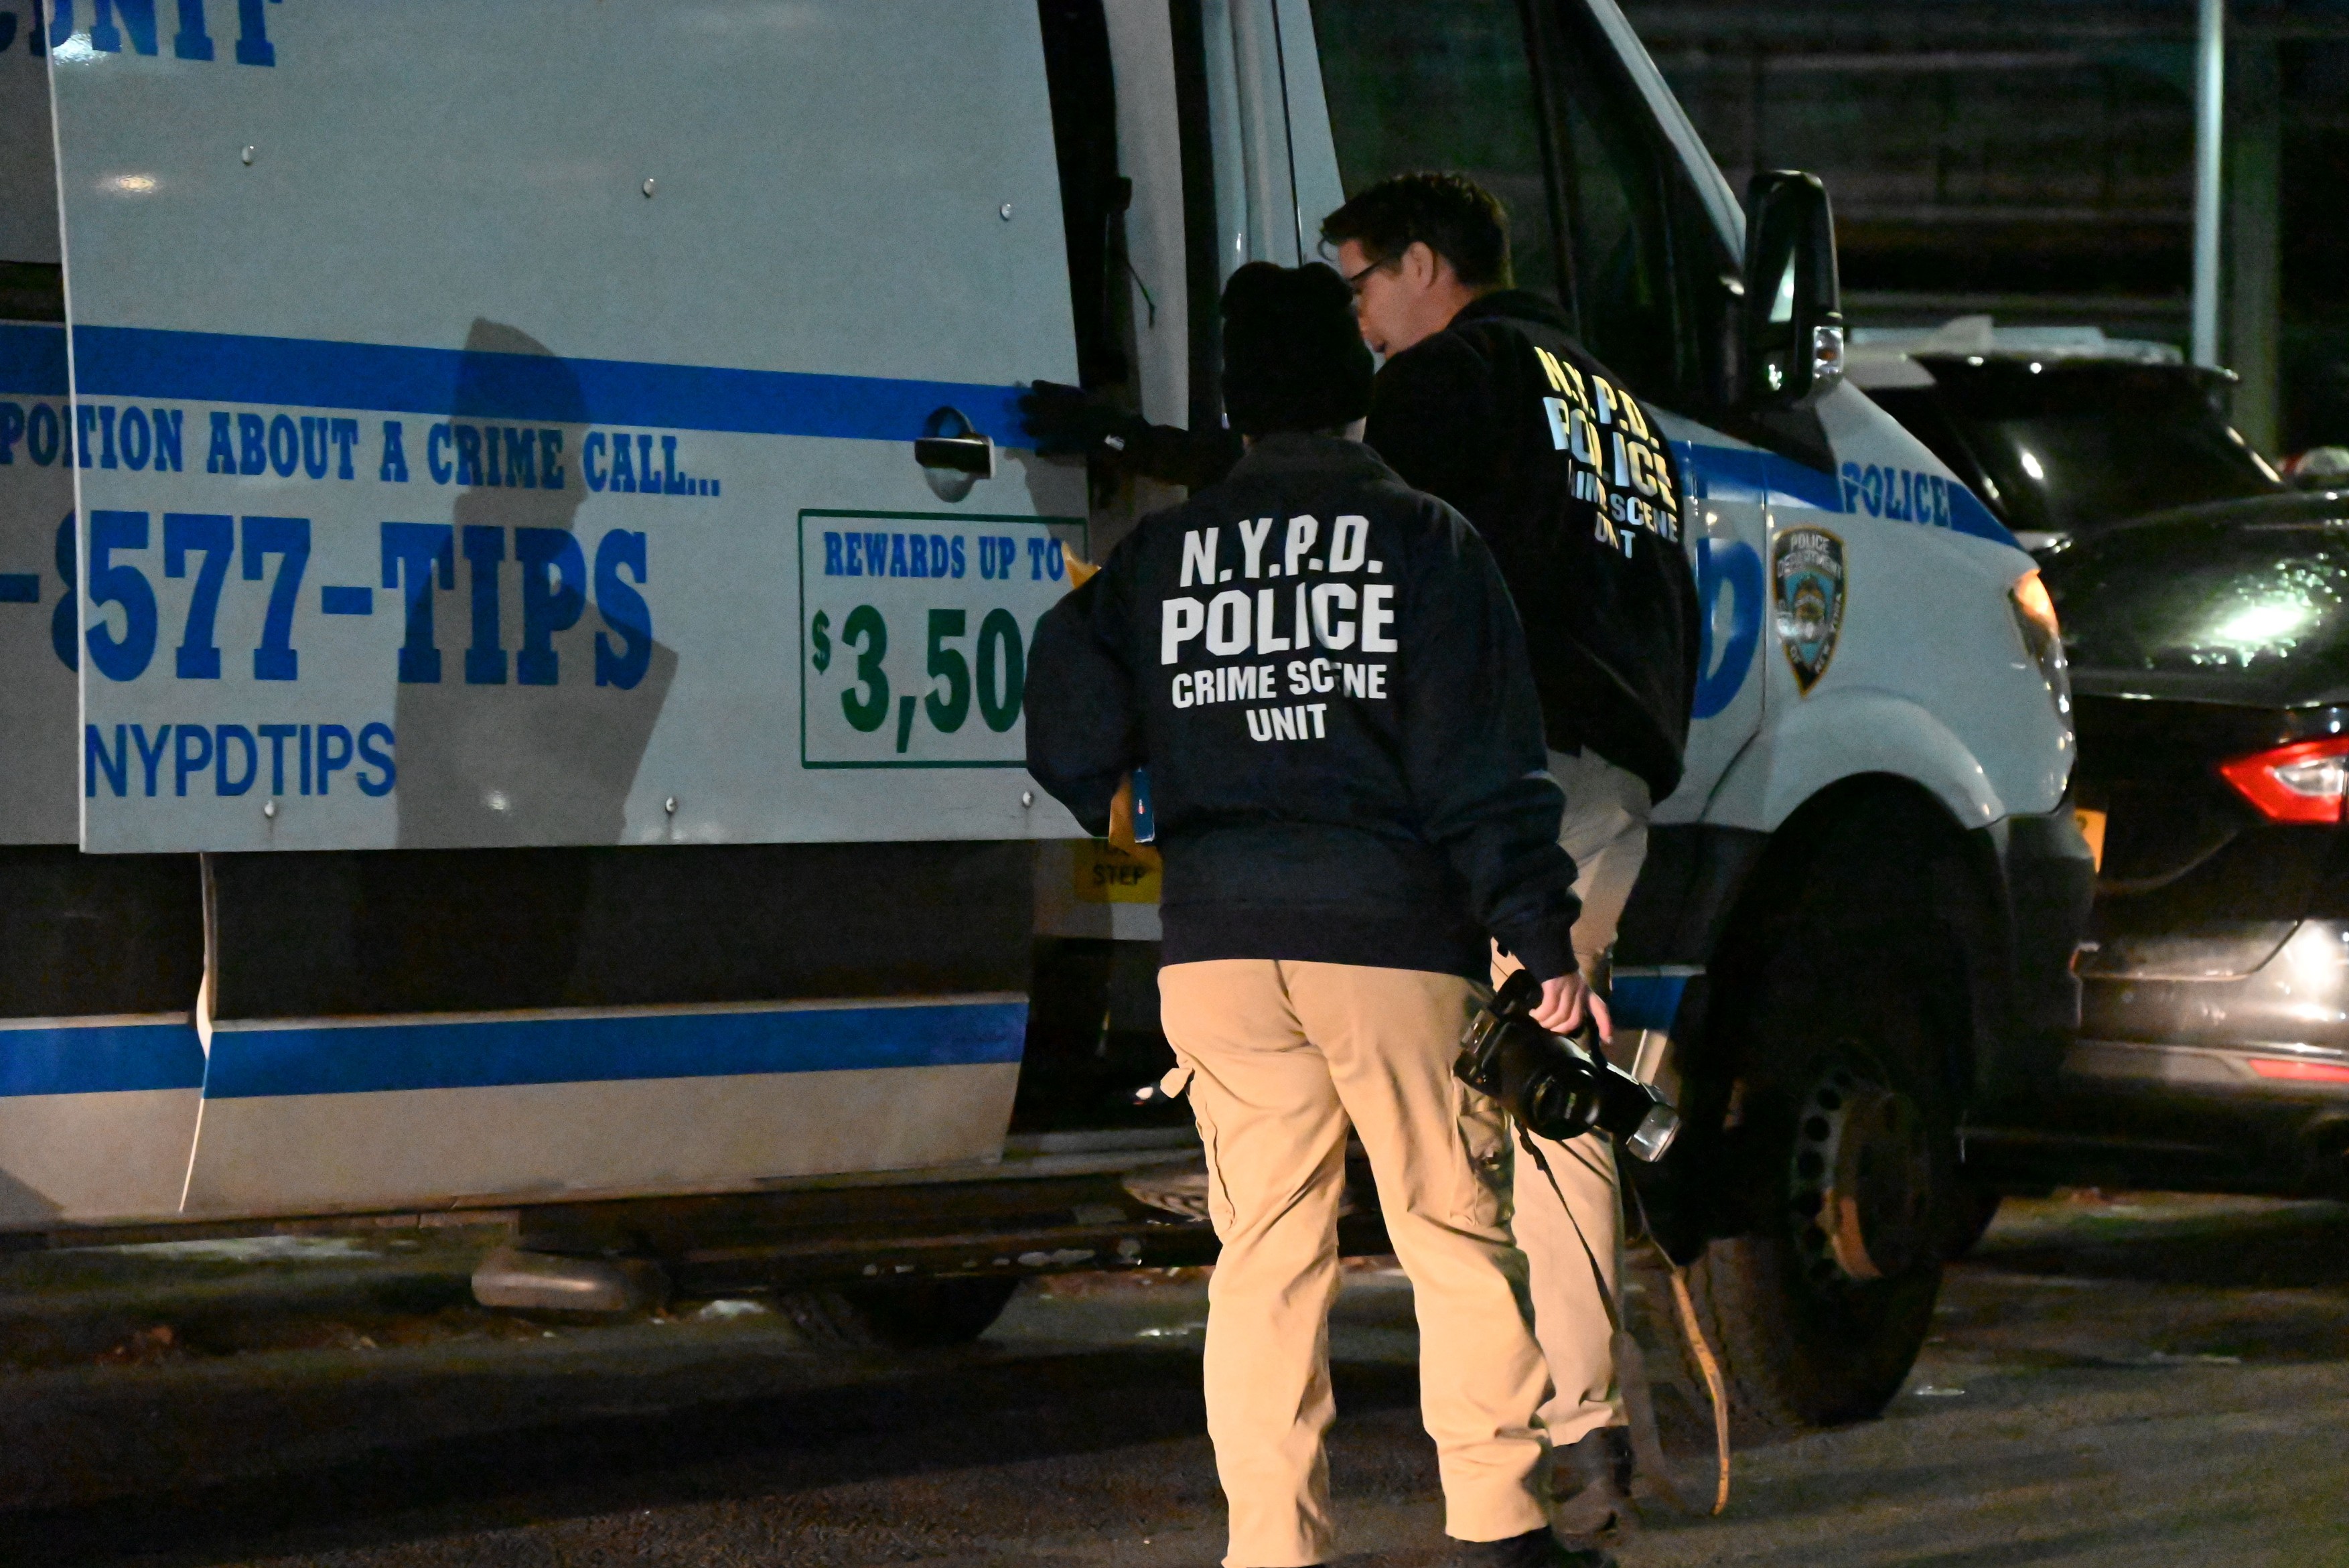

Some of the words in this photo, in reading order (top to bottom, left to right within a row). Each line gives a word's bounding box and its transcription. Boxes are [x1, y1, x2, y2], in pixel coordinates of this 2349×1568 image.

[207, 411, 358, 480] ABOUT
[380, 421, 409, 482] A
[427, 423, 564, 490] CRIME
[583, 431, 720, 496] CALL...
[1543, 397, 1677, 512] POLICE
[1610, 493, 1678, 543] SCENE
[1841, 461, 1948, 526] POLICE
[824, 531, 966, 579] REWARDS
[978, 536, 1016, 580] UP
[1027, 537, 1066, 581] TO
[1180, 514, 1383, 587] N.Y.P.D.
[1595, 512, 1636, 559] UNT
[1161, 582, 1398, 664] POLICE
[811, 605, 1027, 754] $3,50
[1172, 664, 1277, 708] CRIME
[1246, 703, 1327, 741] UNIT
[85, 721, 396, 796] NYPDTIPS
[1092, 863, 1147, 885] STEP
